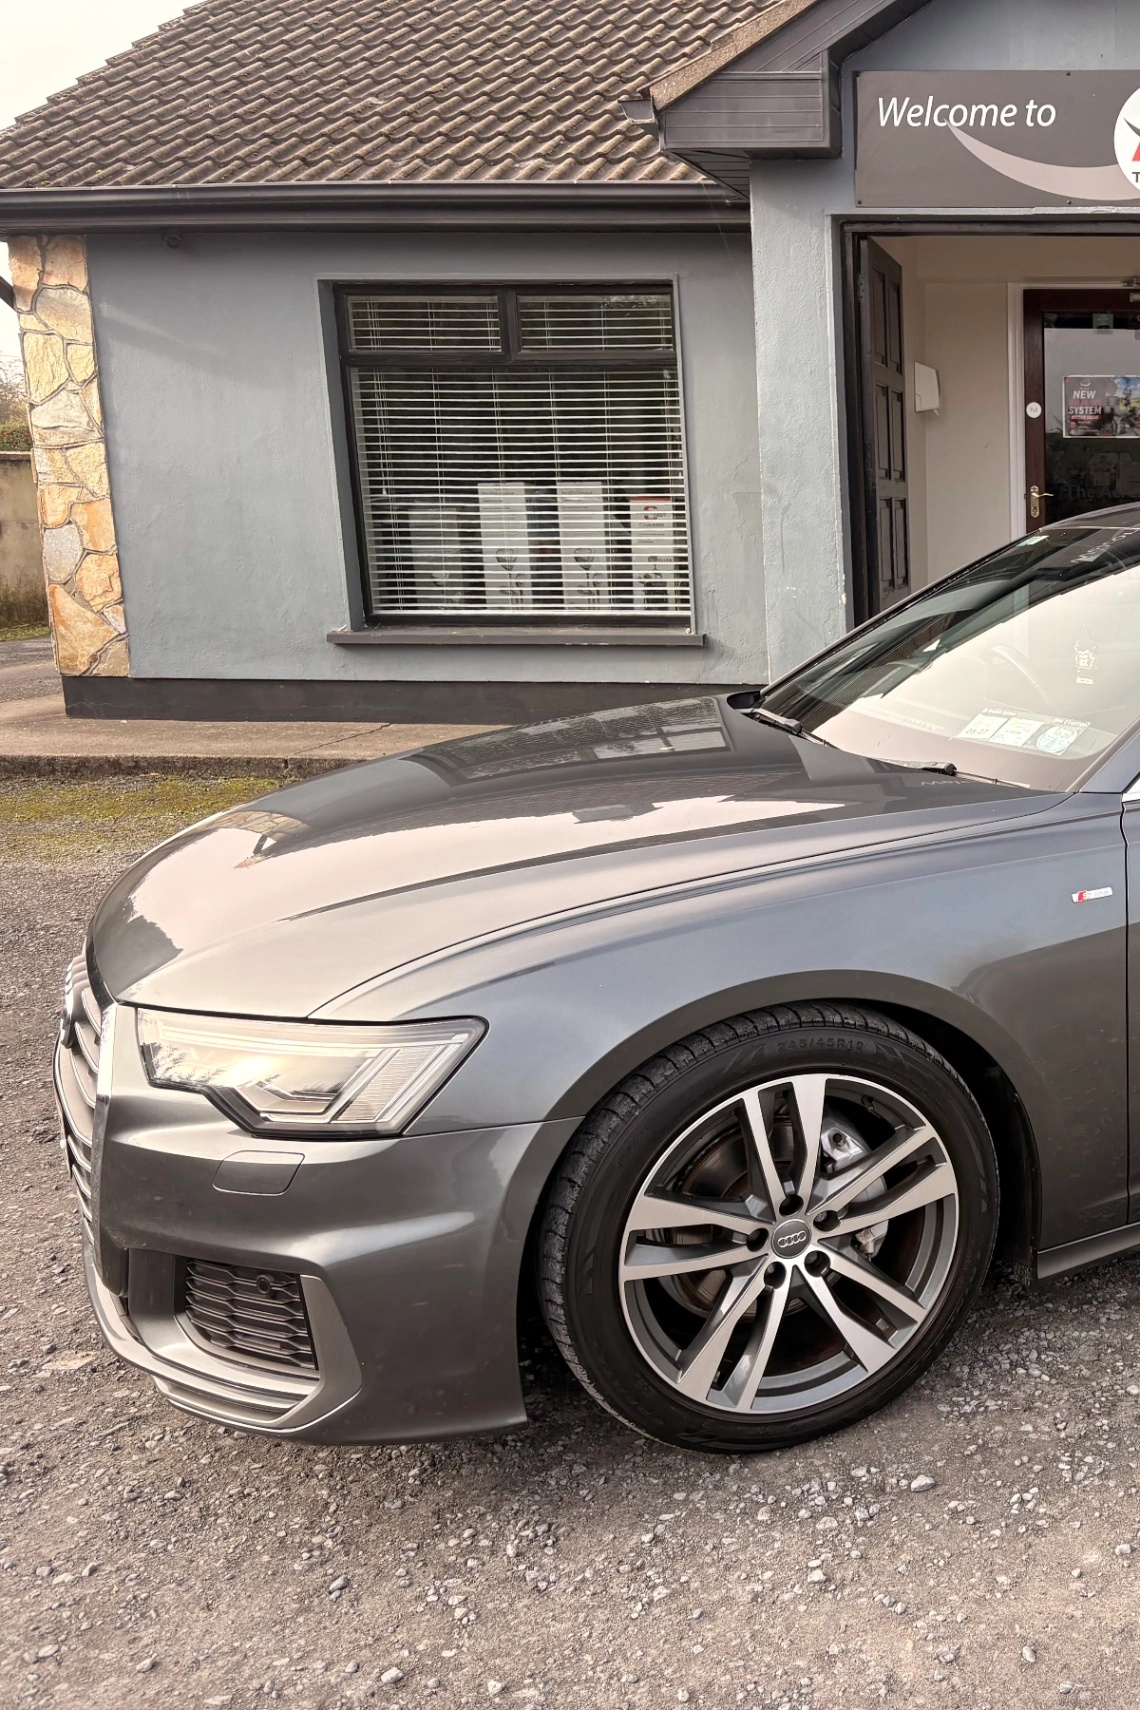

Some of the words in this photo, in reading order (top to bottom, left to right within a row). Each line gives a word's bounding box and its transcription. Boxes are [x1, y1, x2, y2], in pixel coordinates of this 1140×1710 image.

[877, 95, 1017, 127] Welcome
[1025, 100, 1056, 127] to
[1072, 390, 1096, 399] NEW
[1068, 406, 1102, 415] SYSTEM
